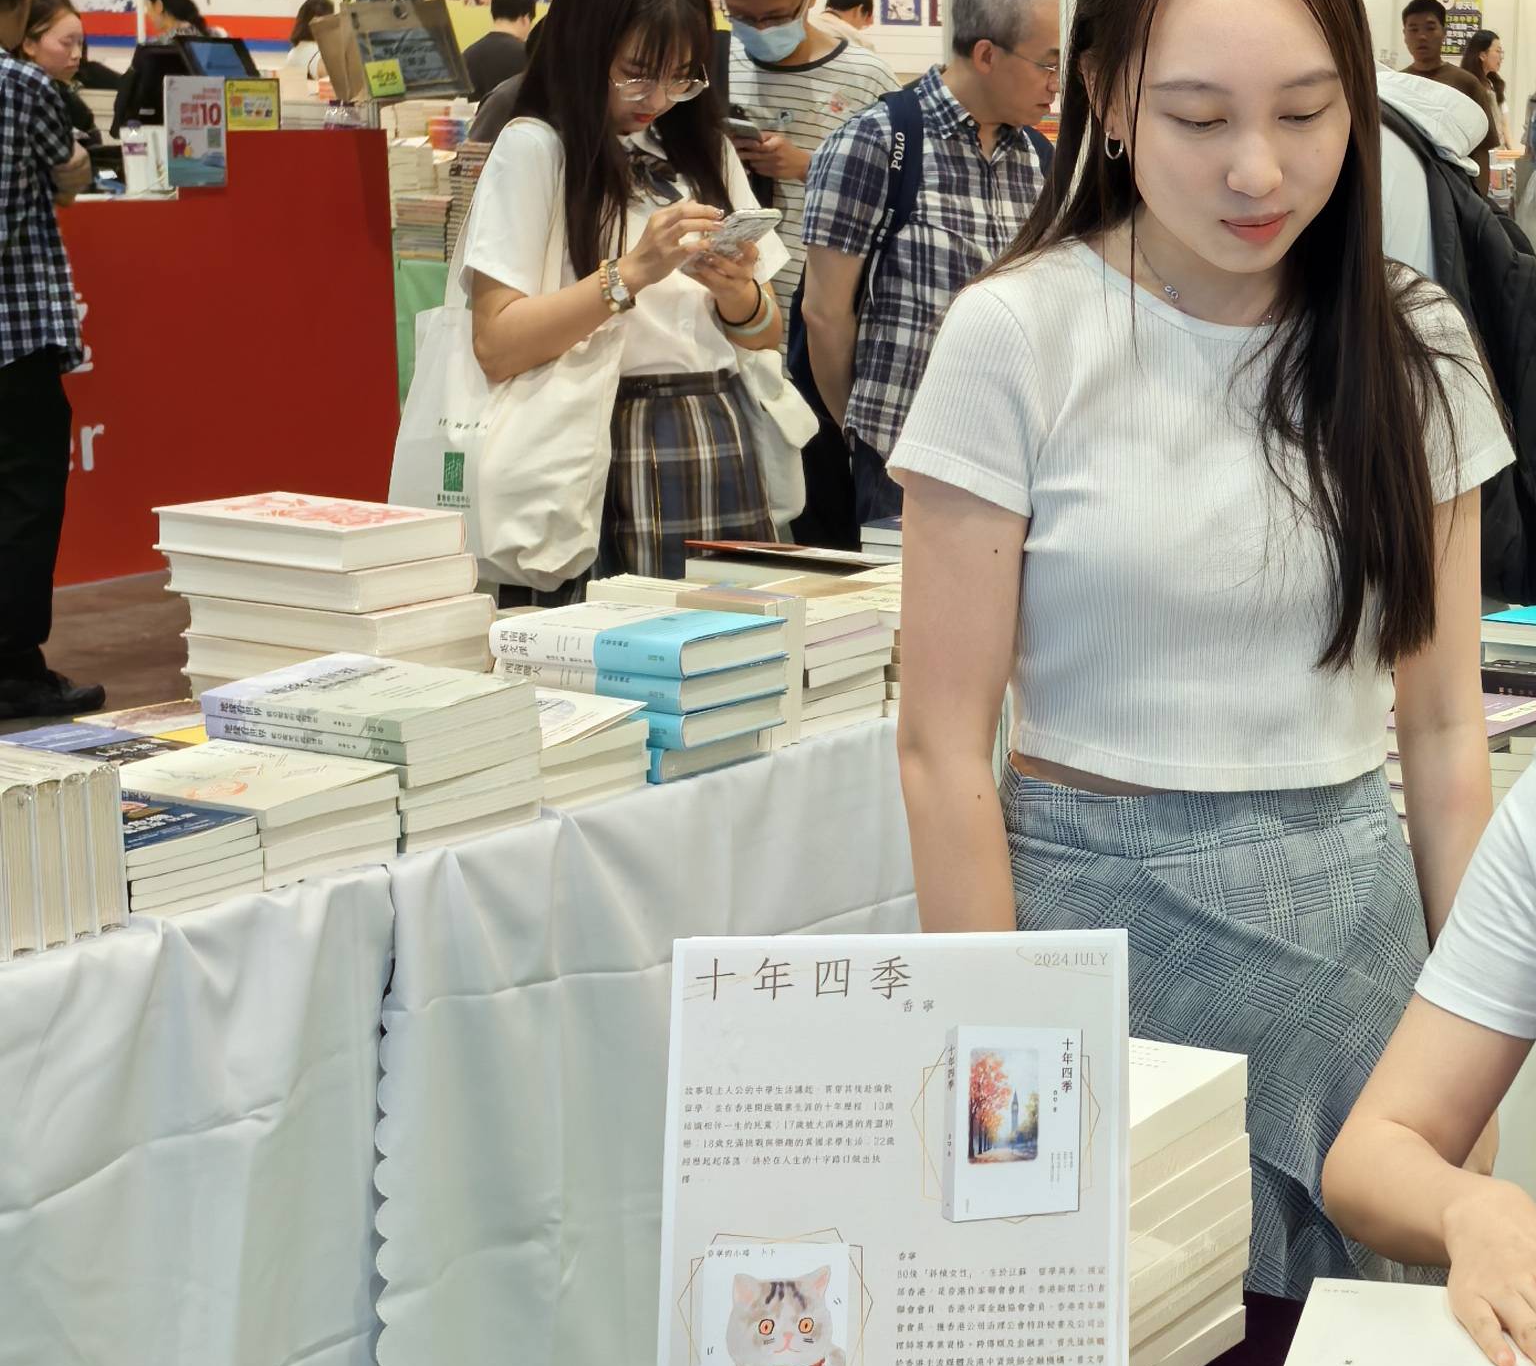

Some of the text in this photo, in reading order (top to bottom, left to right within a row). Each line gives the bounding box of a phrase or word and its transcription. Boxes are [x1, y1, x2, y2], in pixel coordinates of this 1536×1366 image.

[1034, 952, 1108, 967] 2024 JULY
[695, 955, 912, 1001] 十年四季
